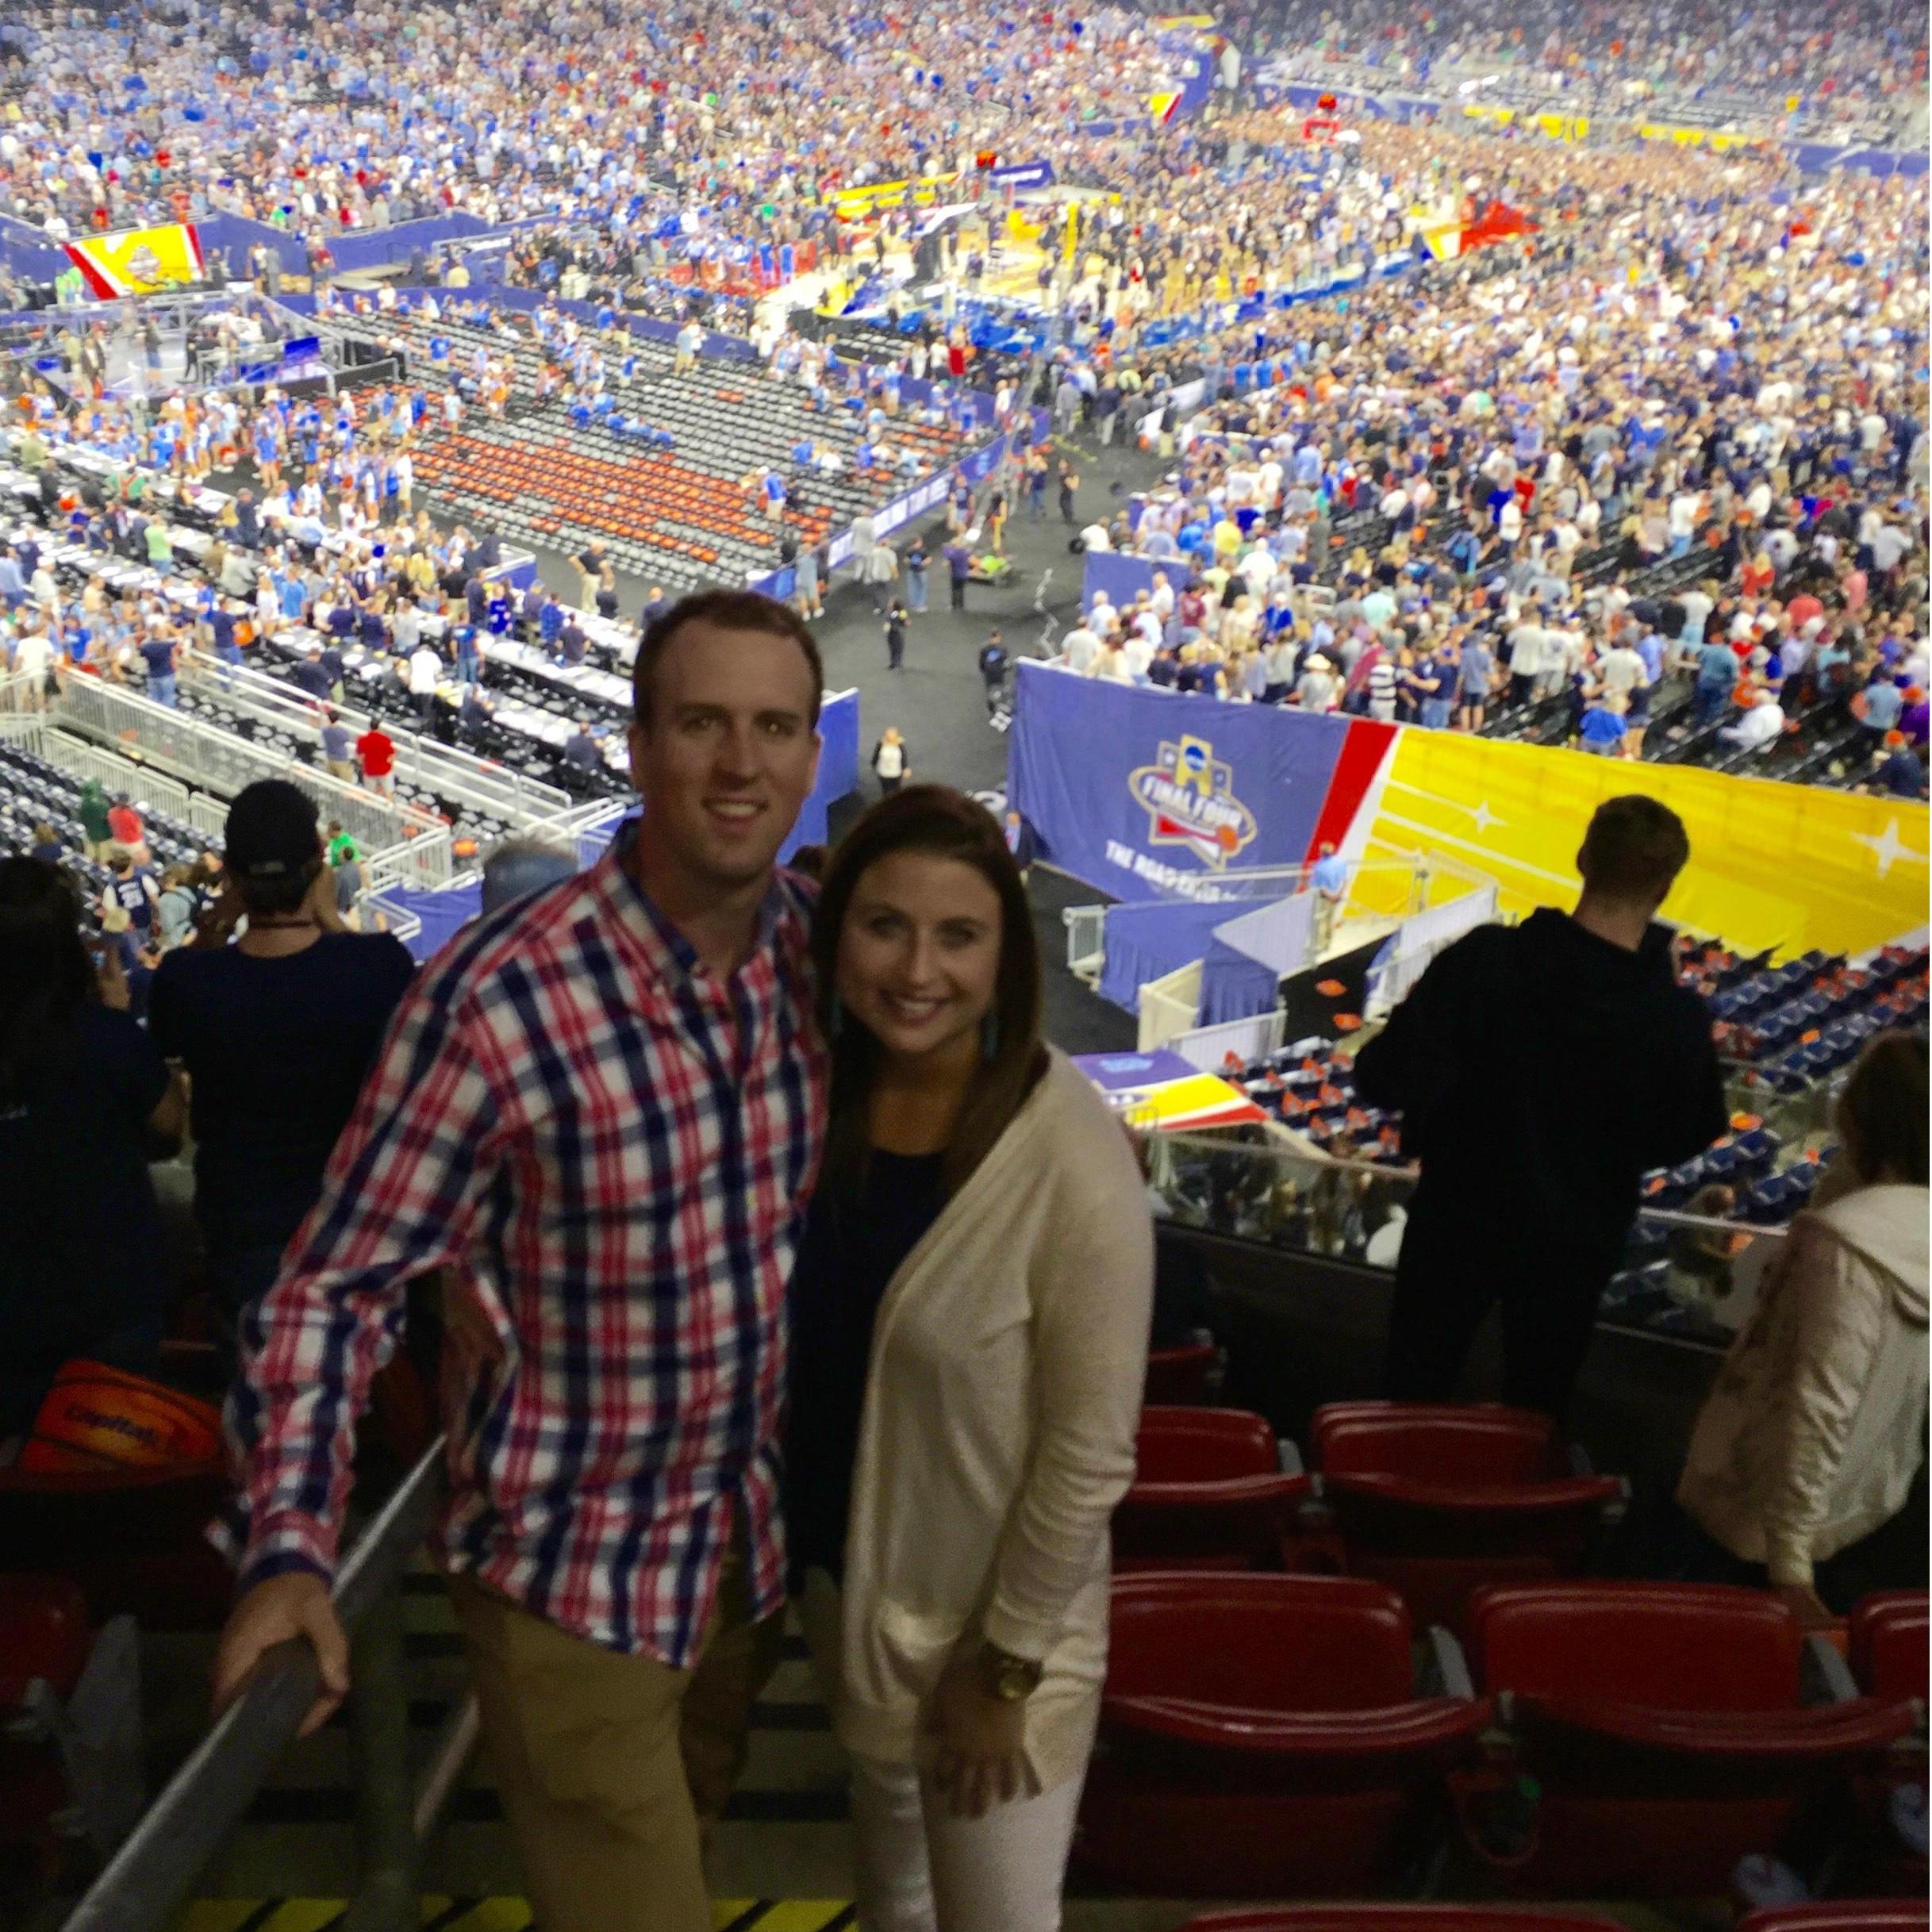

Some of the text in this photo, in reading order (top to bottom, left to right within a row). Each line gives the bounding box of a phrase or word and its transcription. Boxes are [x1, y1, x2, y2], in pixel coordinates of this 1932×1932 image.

[1142, 774, 1243, 830] FINAL FOUR
[1105, 838, 1136, 870] THE
